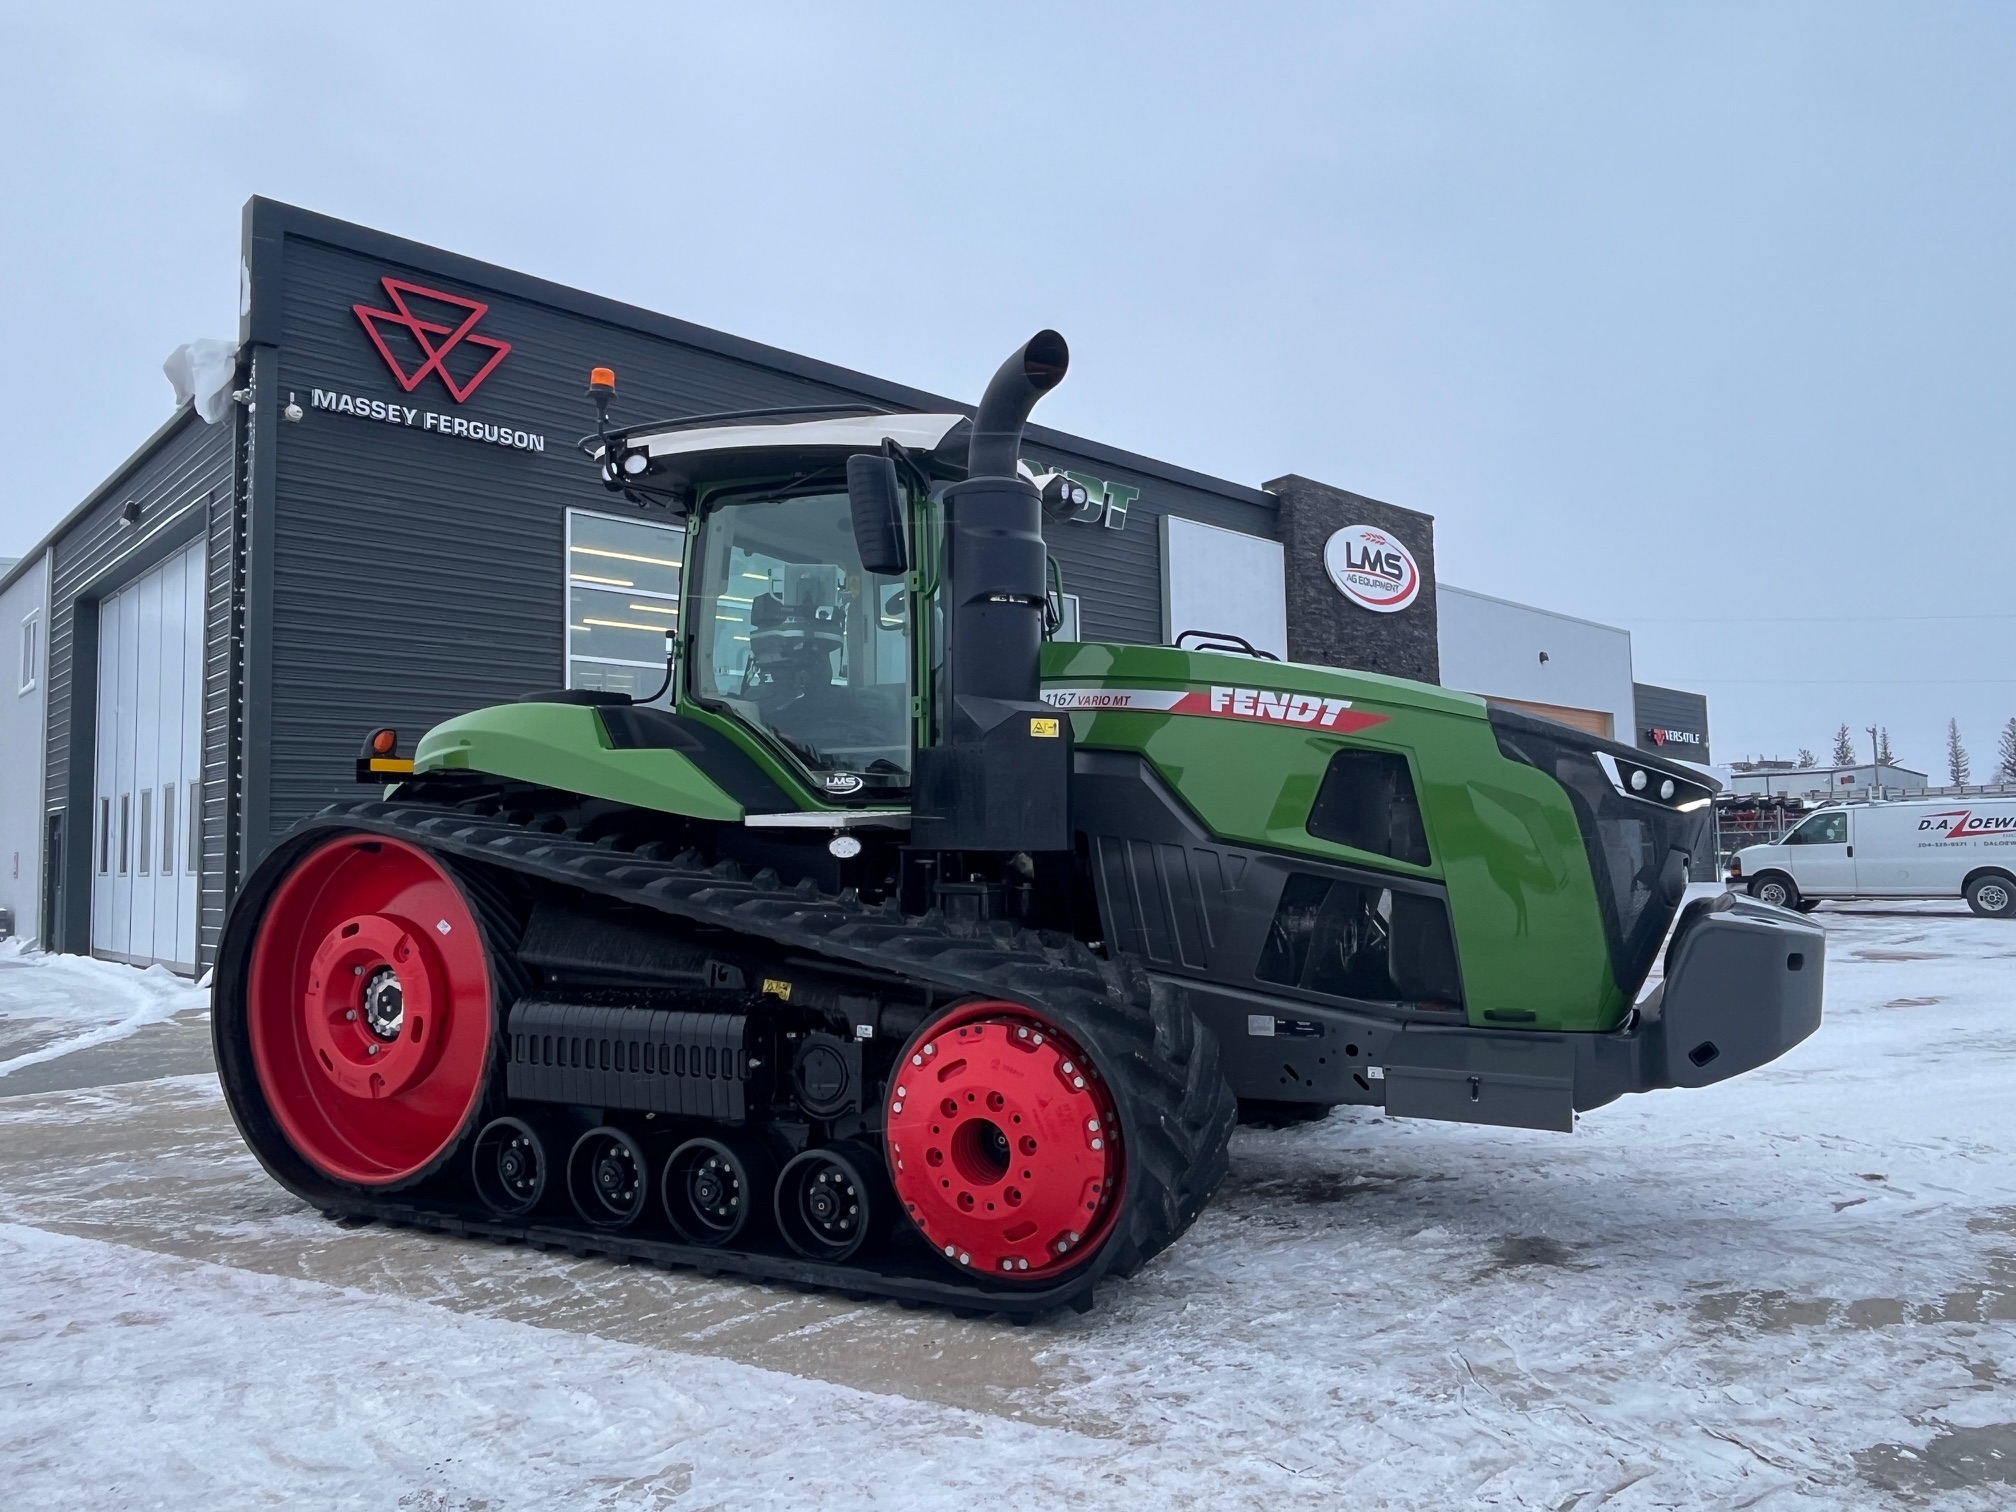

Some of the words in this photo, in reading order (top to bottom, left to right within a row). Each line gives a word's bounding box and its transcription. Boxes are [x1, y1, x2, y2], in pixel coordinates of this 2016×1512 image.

[311, 388, 418, 426] MASSEY
[423, 411, 545, 452] FERGUSON
[1345, 541, 1404, 582] LMS
[1346, 573, 1358, 584] AG
[1358, 576, 1400, 593] EQUIPMENT
[1045, 692, 1077, 707] 1167
[1078, 695, 1111, 706] VARIO
[1112, 695, 1132, 706] MT
[1210, 685, 1353, 727] FENDT
[1664, 729, 1700, 744] VERSATILE
[826, 776, 856, 786] LMS
